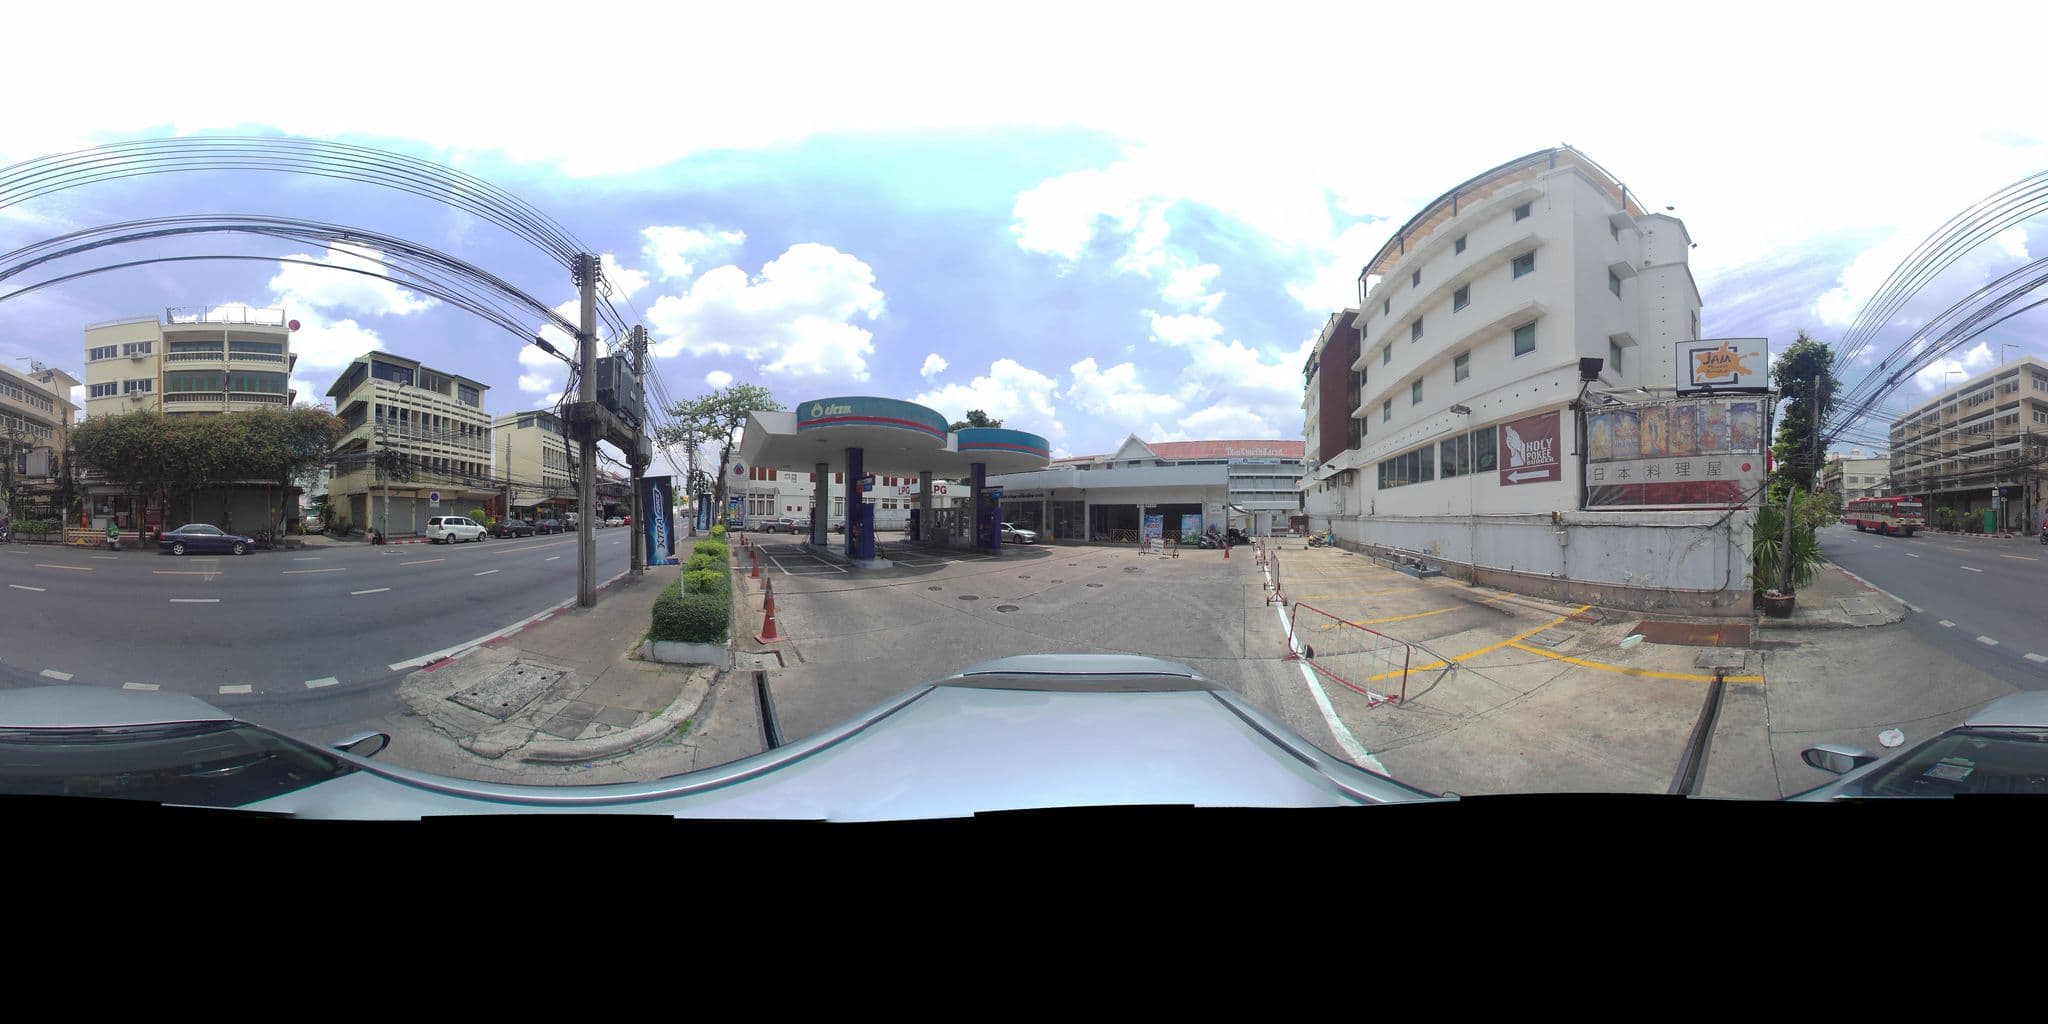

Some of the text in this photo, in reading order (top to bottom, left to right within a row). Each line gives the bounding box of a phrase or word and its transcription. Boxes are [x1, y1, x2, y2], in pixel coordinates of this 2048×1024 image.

[1703, 352, 1731, 365] JAM
[1526, 438, 1553, 452] HOLY
[1526, 449, 1552, 462] POKEE
[1594, 461, 1722, 481] 日本料理屋
[898, 486, 910, 495] LPG
